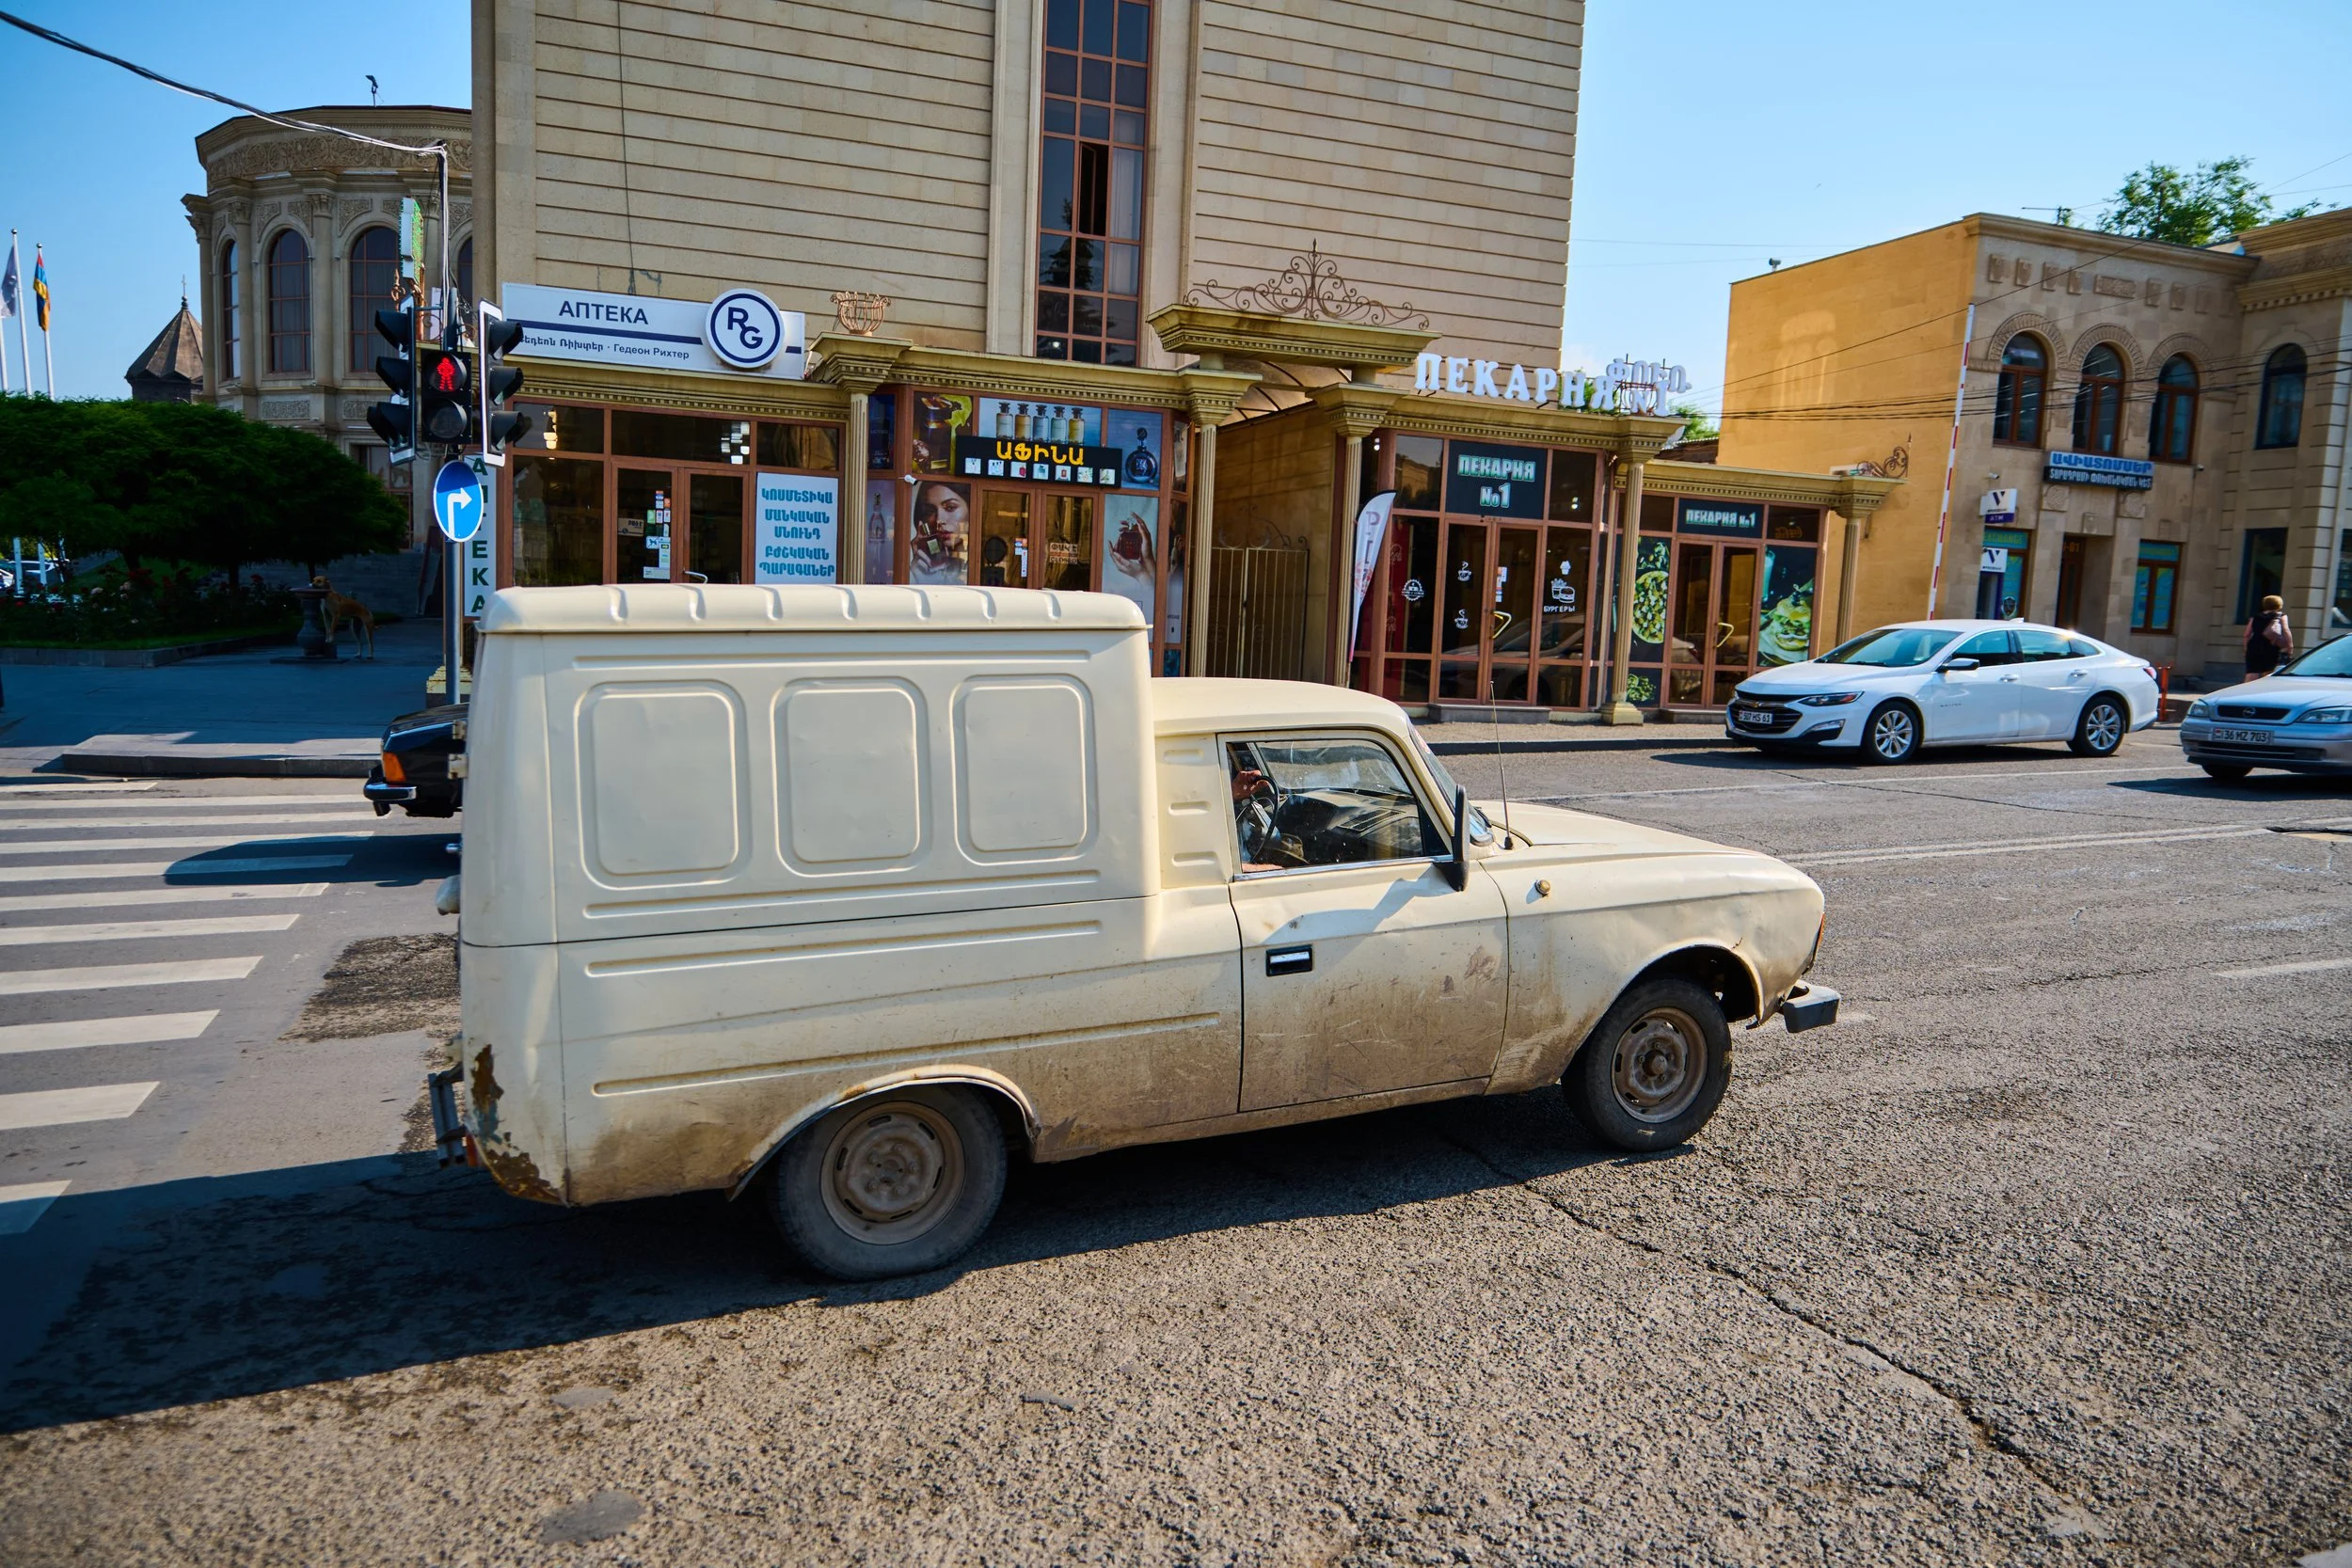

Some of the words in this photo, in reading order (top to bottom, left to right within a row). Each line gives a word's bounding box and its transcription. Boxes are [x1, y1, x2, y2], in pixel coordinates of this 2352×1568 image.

[559, 300, 649, 325] АПТЕКА
[521, 335, 556, 347] եդեոն
[613, 343, 651, 356] Гедеон
[654, 348, 690, 360] Рихтер
[1414, 352, 1615, 411] ПЕКАРНЯ
[996, 440, 1085, 466] ԱՖԻՆԱ
[1457, 454, 1535, 483] ПЕКАРНЯ
[761, 487, 834, 504] ԿՈՍՄԵՏԻԿԱ
[765, 508, 830, 524] ՄԱՆԿԱԿԱՆ
[1686, 509, 1738, 527] ПЕКАРНЯ
[470, 457, 488, 613] АЕКА
[774, 526, 821, 540] ՍՆՈՒՆԴ
[765, 546, 830, 561] ԲԺՇԿԱԿԱՆ
[759, 562, 835, 577] ՊԱՐԱԳԱՆԵՐ
